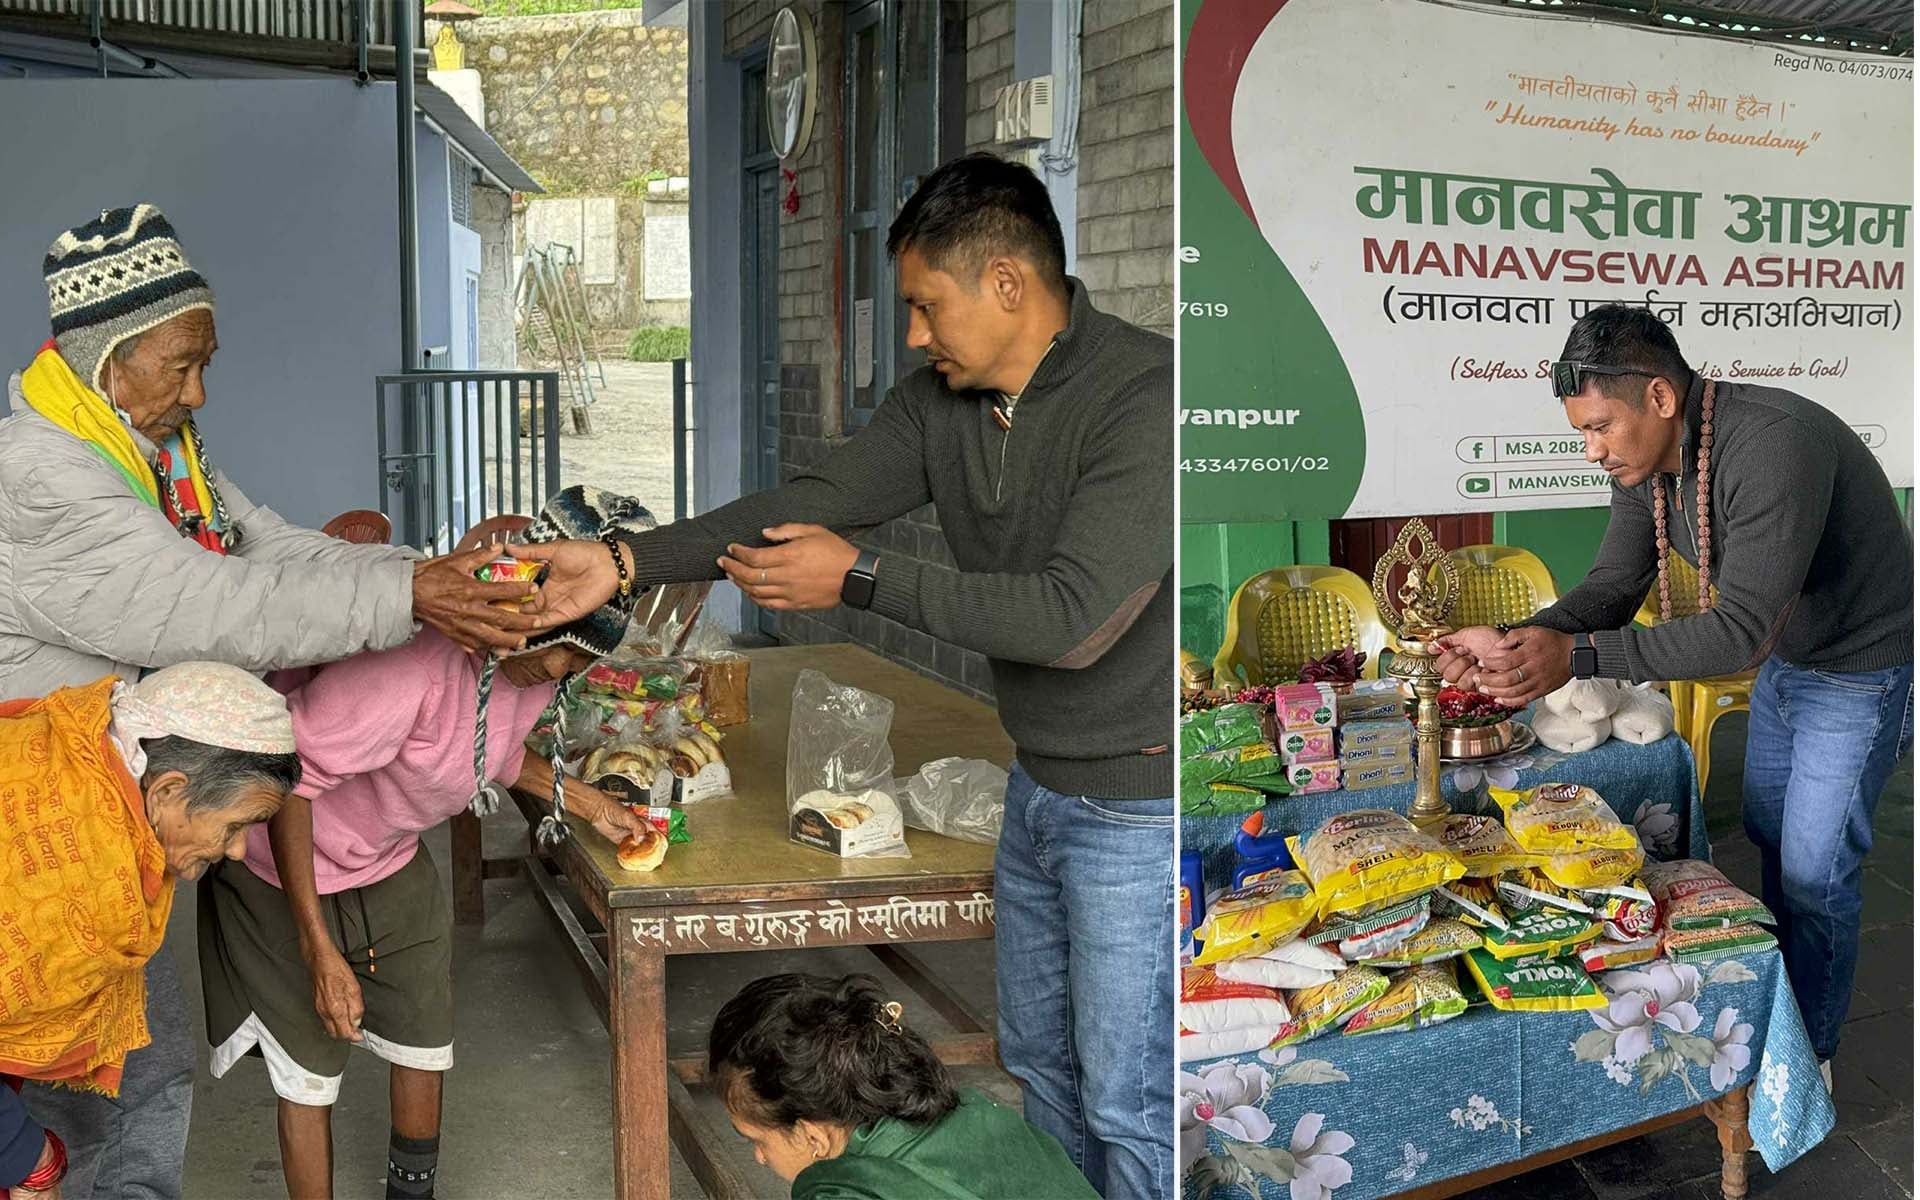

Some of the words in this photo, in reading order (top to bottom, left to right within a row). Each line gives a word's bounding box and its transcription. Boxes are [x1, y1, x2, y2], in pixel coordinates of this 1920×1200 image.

[1774, 53, 1810, 73] Regd
[1813, 57, 1836, 73] No.
[1838, 60, 1913, 82] 04/073/074
[1646, 85, 1680, 114] कुनै
[1687, 90, 1727, 115] सीमा
[1624, 117, 1665, 138] has
[1670, 126, 1700, 141] no
[1353, 166, 1702, 241] मानवसेवा
[1724, 194, 1912, 249] आश्रम
[1362, 237, 1708, 286] MANAVSEWA
[1723, 256, 1904, 290] ASHRAM
[1383, 285, 1555, 324] (मानवता
[1699, 297, 1902, 331] महाअभियान)
[1450, 356, 1528, 382] (Selfless
[1710, 364, 1723, 378] is
[1729, 360, 1786, 379] Service
[1787, 361, 1805, 377] to
[1808, 356, 1849, 379] God)
[1505, 442, 1544, 455] MSA
[1356, 851, 1397, 869] SHELL
[673, 914, 712, 950] नर
[817, 899, 854, 939] को
[857, 895, 950, 939] स्मृतिमा
[1504, 965, 1577, 983] TOKLA
